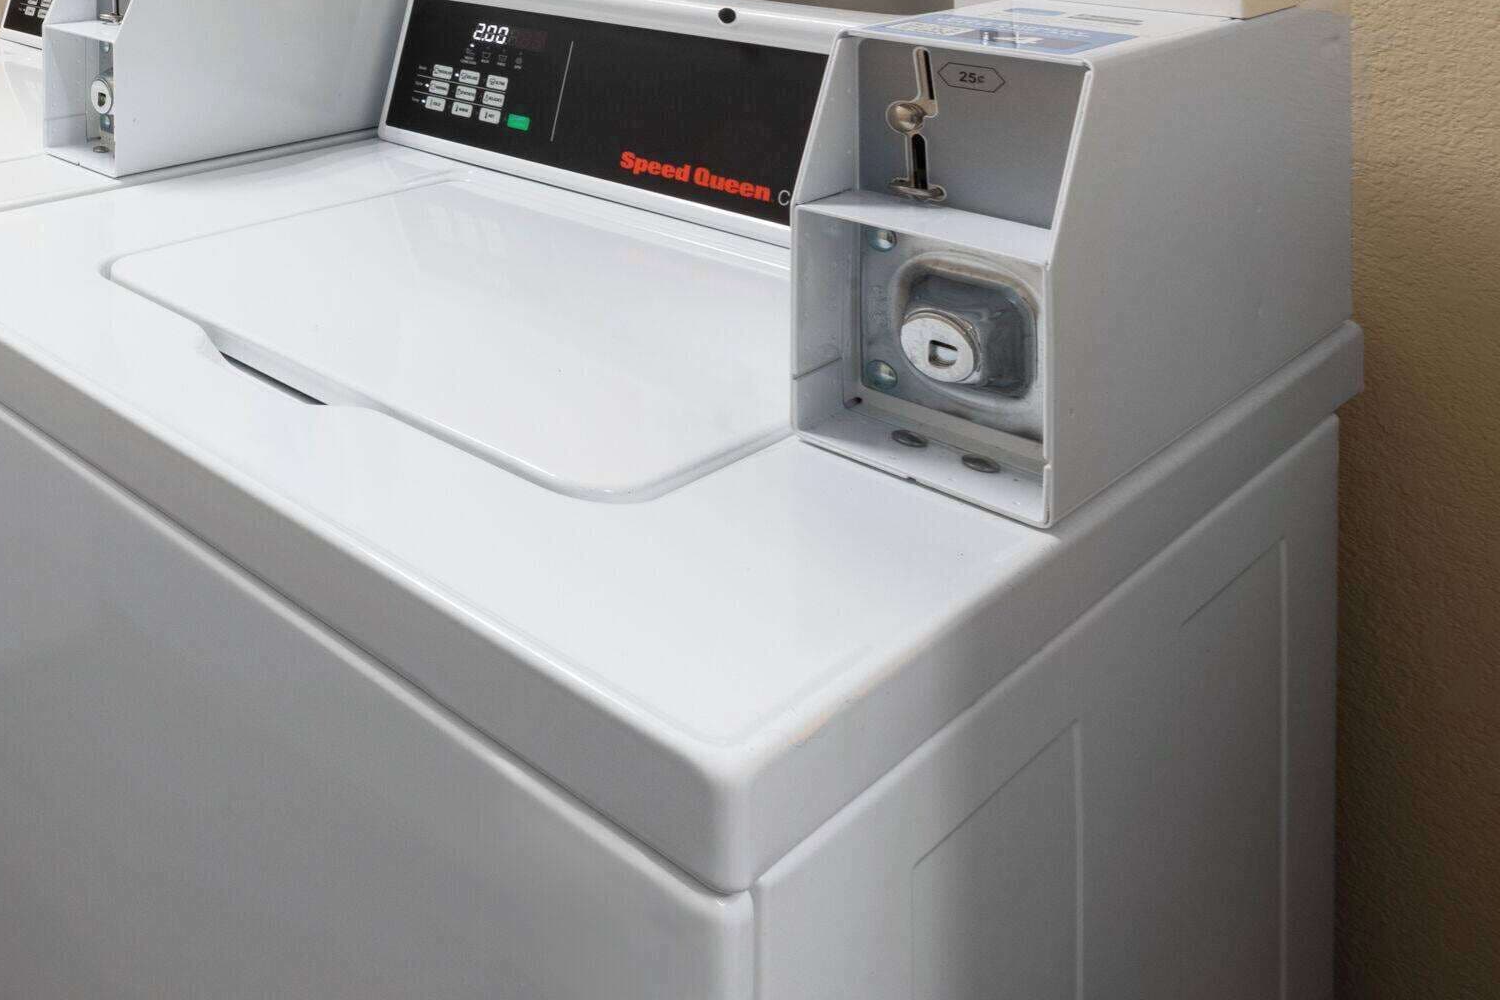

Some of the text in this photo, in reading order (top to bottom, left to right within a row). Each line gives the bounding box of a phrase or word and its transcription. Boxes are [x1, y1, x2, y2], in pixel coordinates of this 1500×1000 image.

[473, 23, 509, 44] 2.00
[959, 70, 986, 85] 25¢
[620, 150, 691, 182] Speed
[693, 167, 771, 201] Queen
